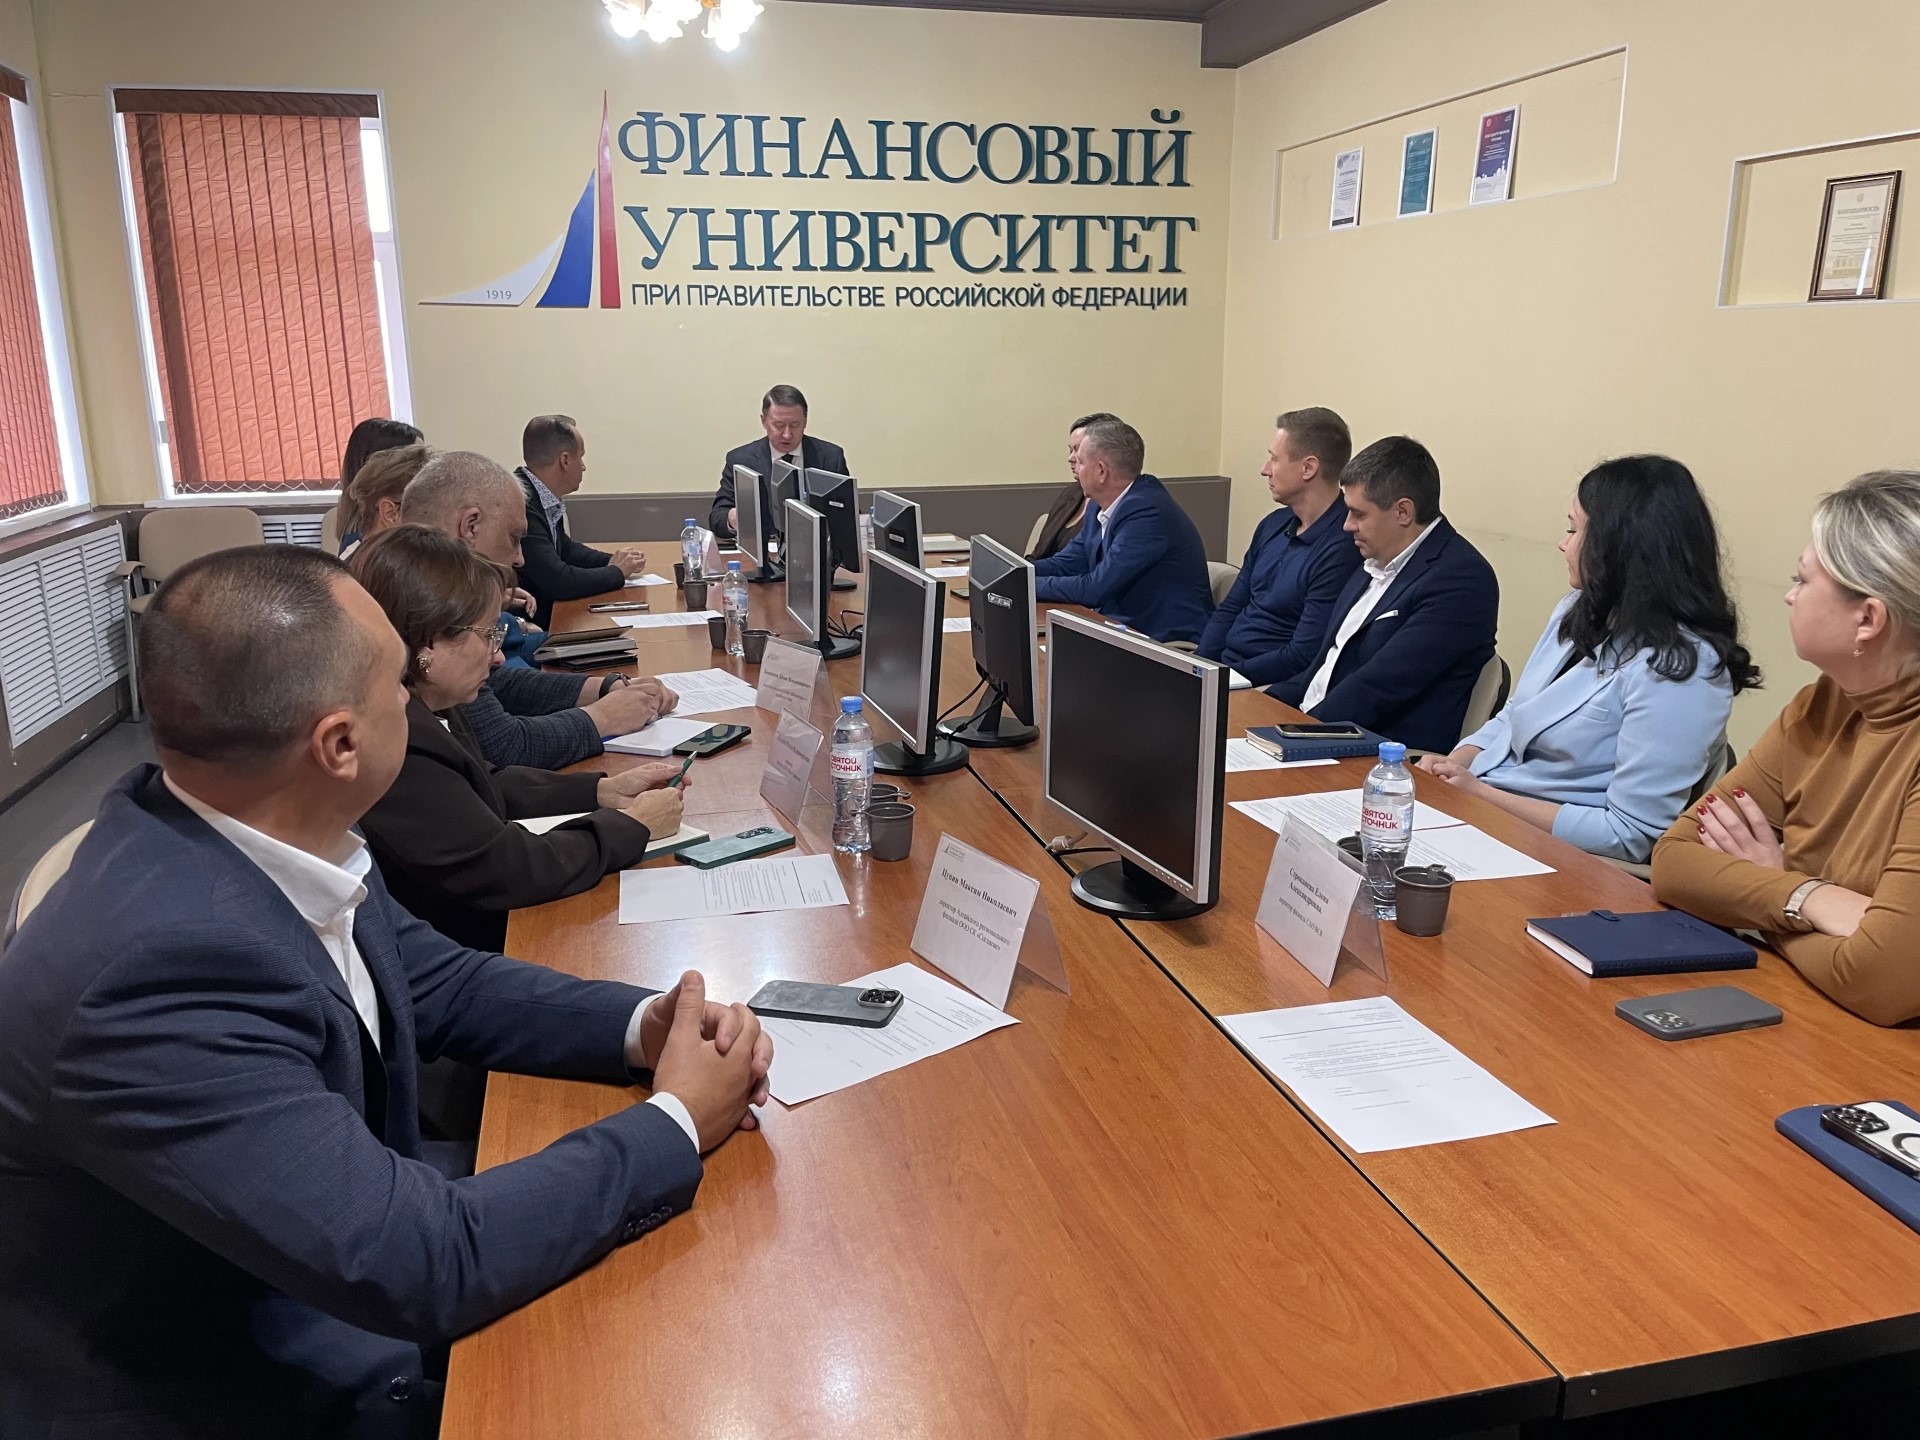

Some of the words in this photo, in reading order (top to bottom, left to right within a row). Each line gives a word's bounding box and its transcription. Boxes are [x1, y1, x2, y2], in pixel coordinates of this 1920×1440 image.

[618, 108, 1193, 187] ФИНАНСОВЫЙ
[623, 205, 1197, 273] УНИВЕРСИТЕТ
[486, 290, 512, 299] 1919
[632, 284, 680, 306] ПРИ
[687, 284, 885, 307] ПРАВИТЕЛЬСТВЕ
[896, 283, 1045, 307] РОССИЙСКОЙ
[1052, 286, 1188, 310] ФЕДЕРАЦИИ
[831, 762, 862, 772] СТОЧНИК
